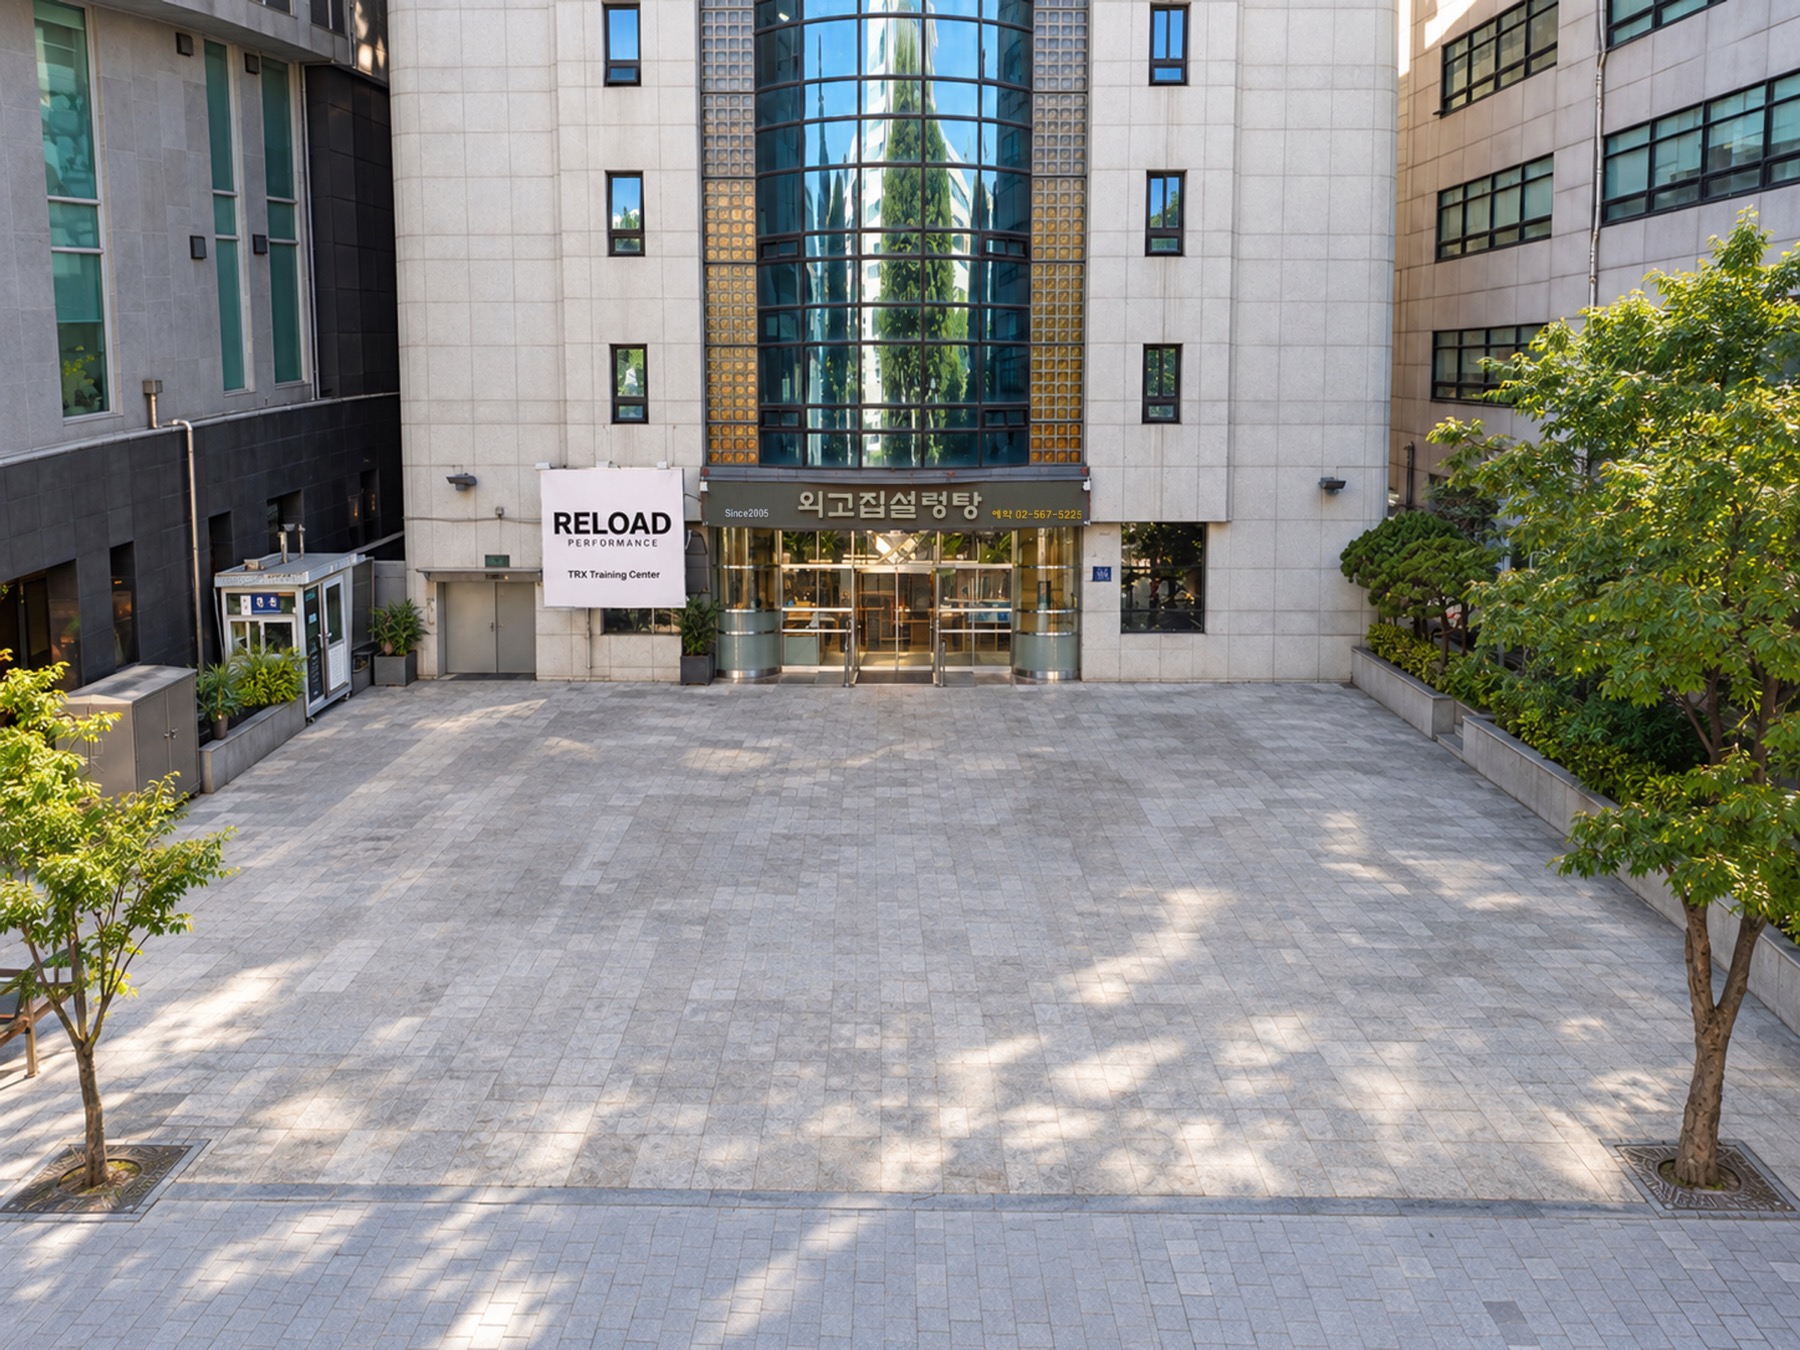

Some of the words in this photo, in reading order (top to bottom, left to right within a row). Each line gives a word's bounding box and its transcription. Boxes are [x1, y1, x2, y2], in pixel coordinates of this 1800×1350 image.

[797, 490, 982, 520] 외고집설렁탕
[992, 509, 1012, 520] 예약
[1015, 509, 1083, 520] 02-567-5225
[554, 511, 672, 535] RELOAD
[567, 538, 658, 548] PERFORMANCE
[568, 570, 587, 579] TRX
[590, 570, 627, 581] Training
[629, 570, 660, 579] Center
